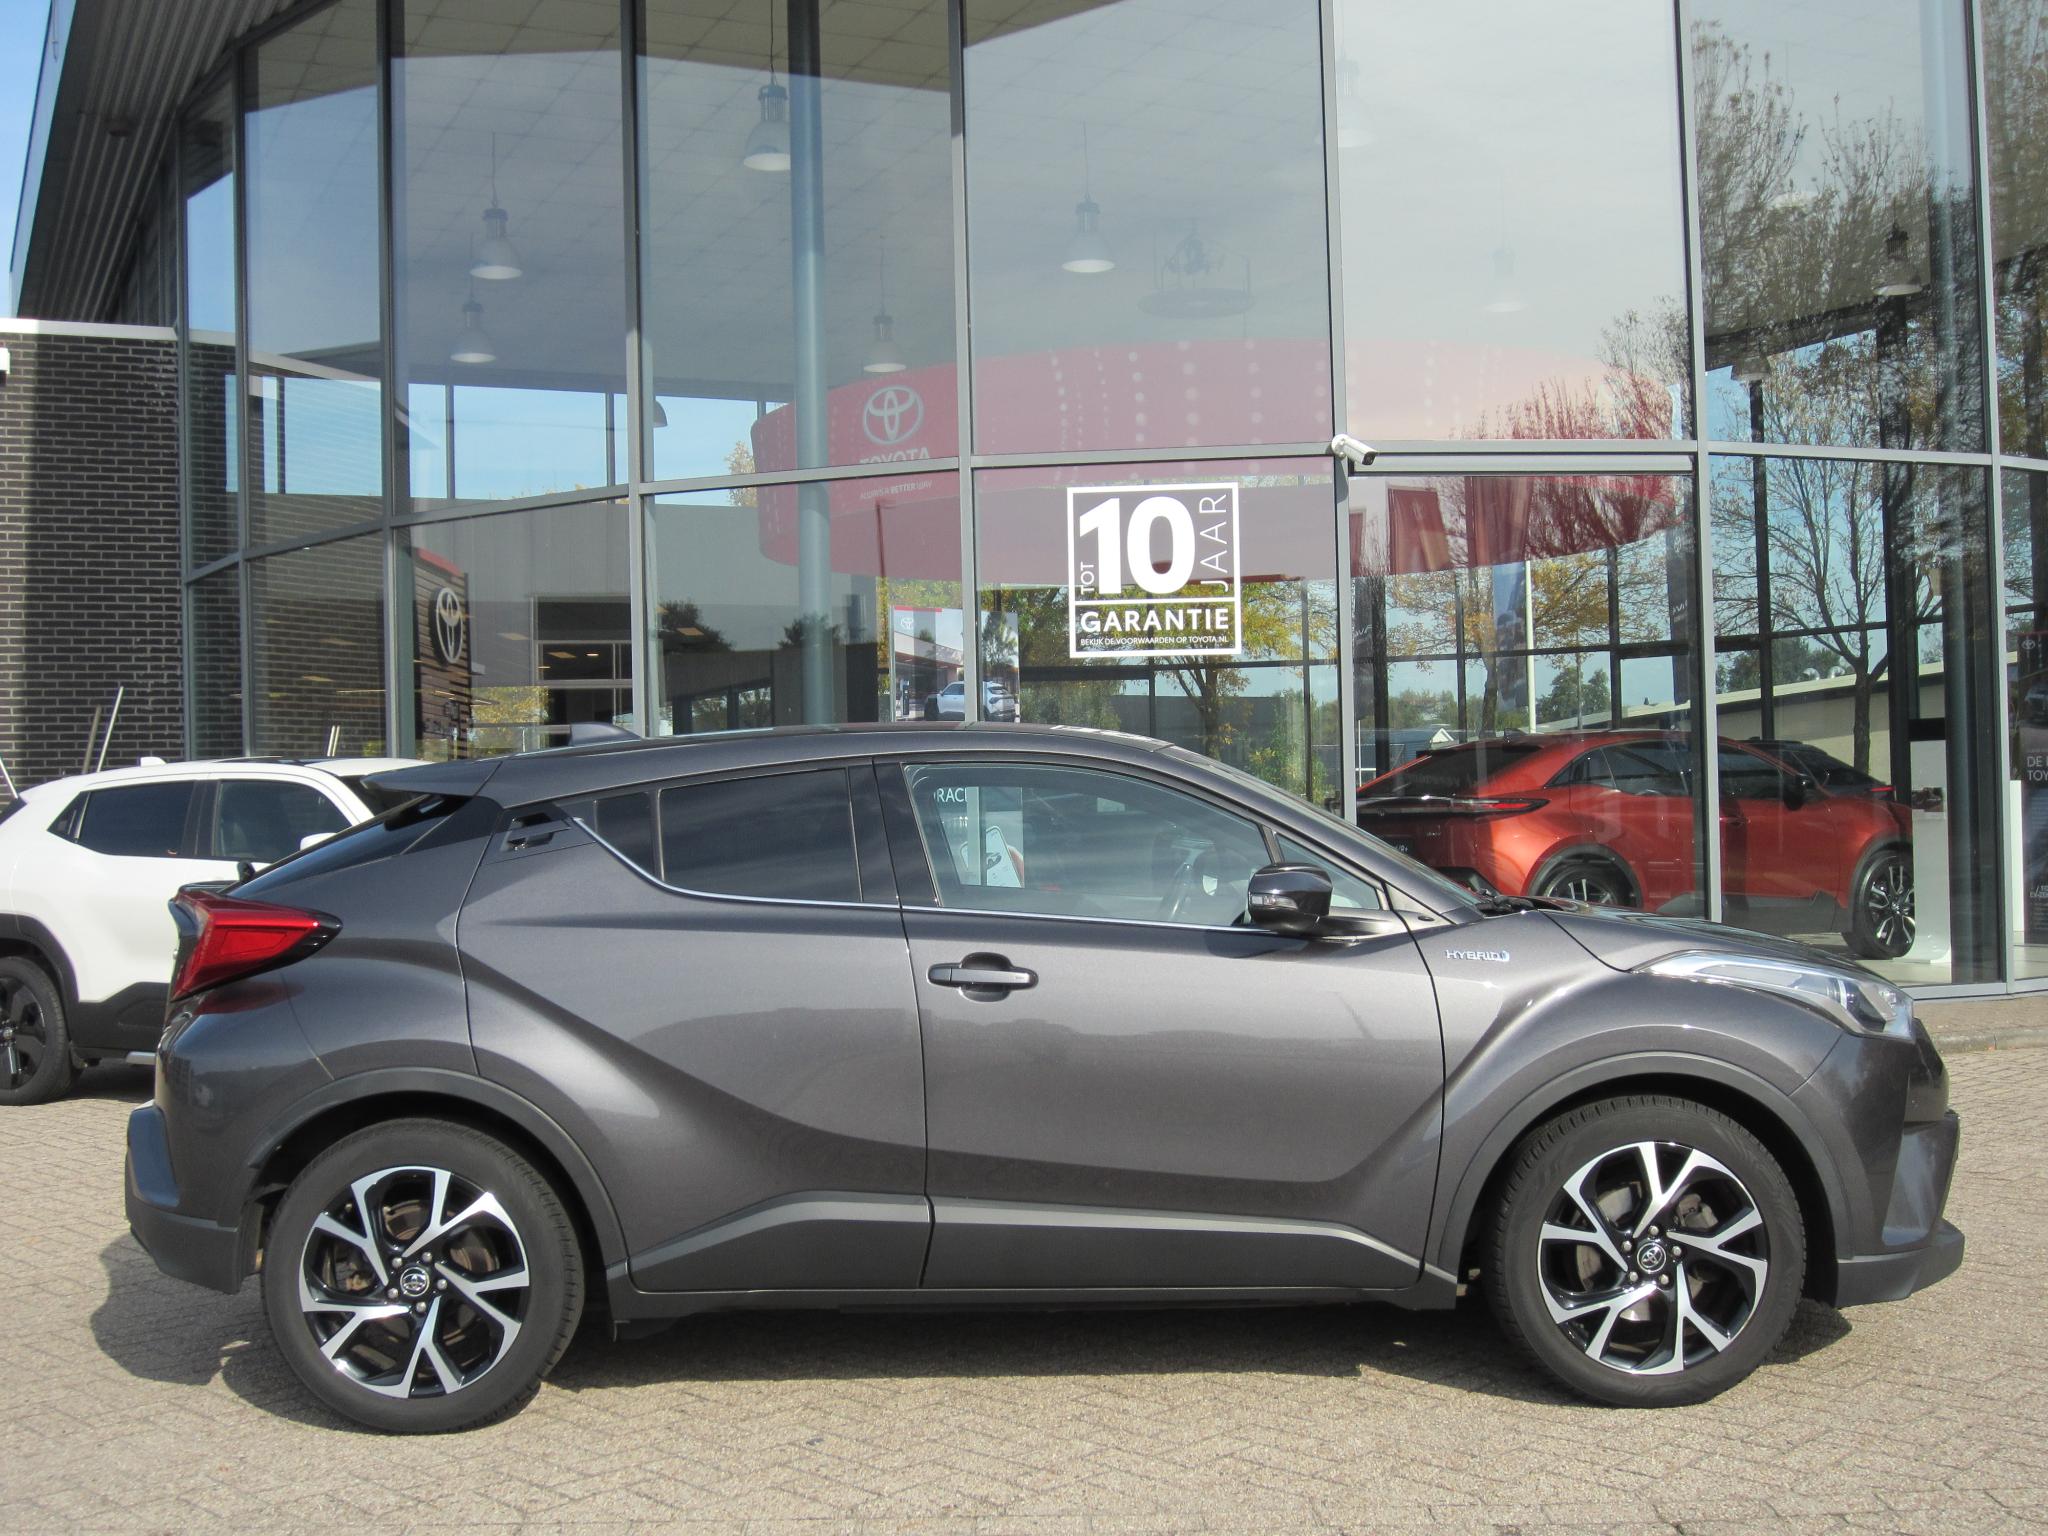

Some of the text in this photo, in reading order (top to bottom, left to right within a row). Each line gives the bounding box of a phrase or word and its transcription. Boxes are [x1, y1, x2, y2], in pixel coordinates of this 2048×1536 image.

[859, 447, 928, 463] OYOTA
[1080, 494, 1228, 595] TOT 10 JAAR
[1080, 608, 1229, 632] GARANTIE
[1080, 637, 1104, 646] BEKIJK
[1104, 637, 1114, 645] DE
[1115, 636, 1174, 645] VOORWAARDEN
[1176, 636, 1187, 644] OP
[933, 787, 968, 803] RAC
[1446, 949, 1501, 961] HYBRID
